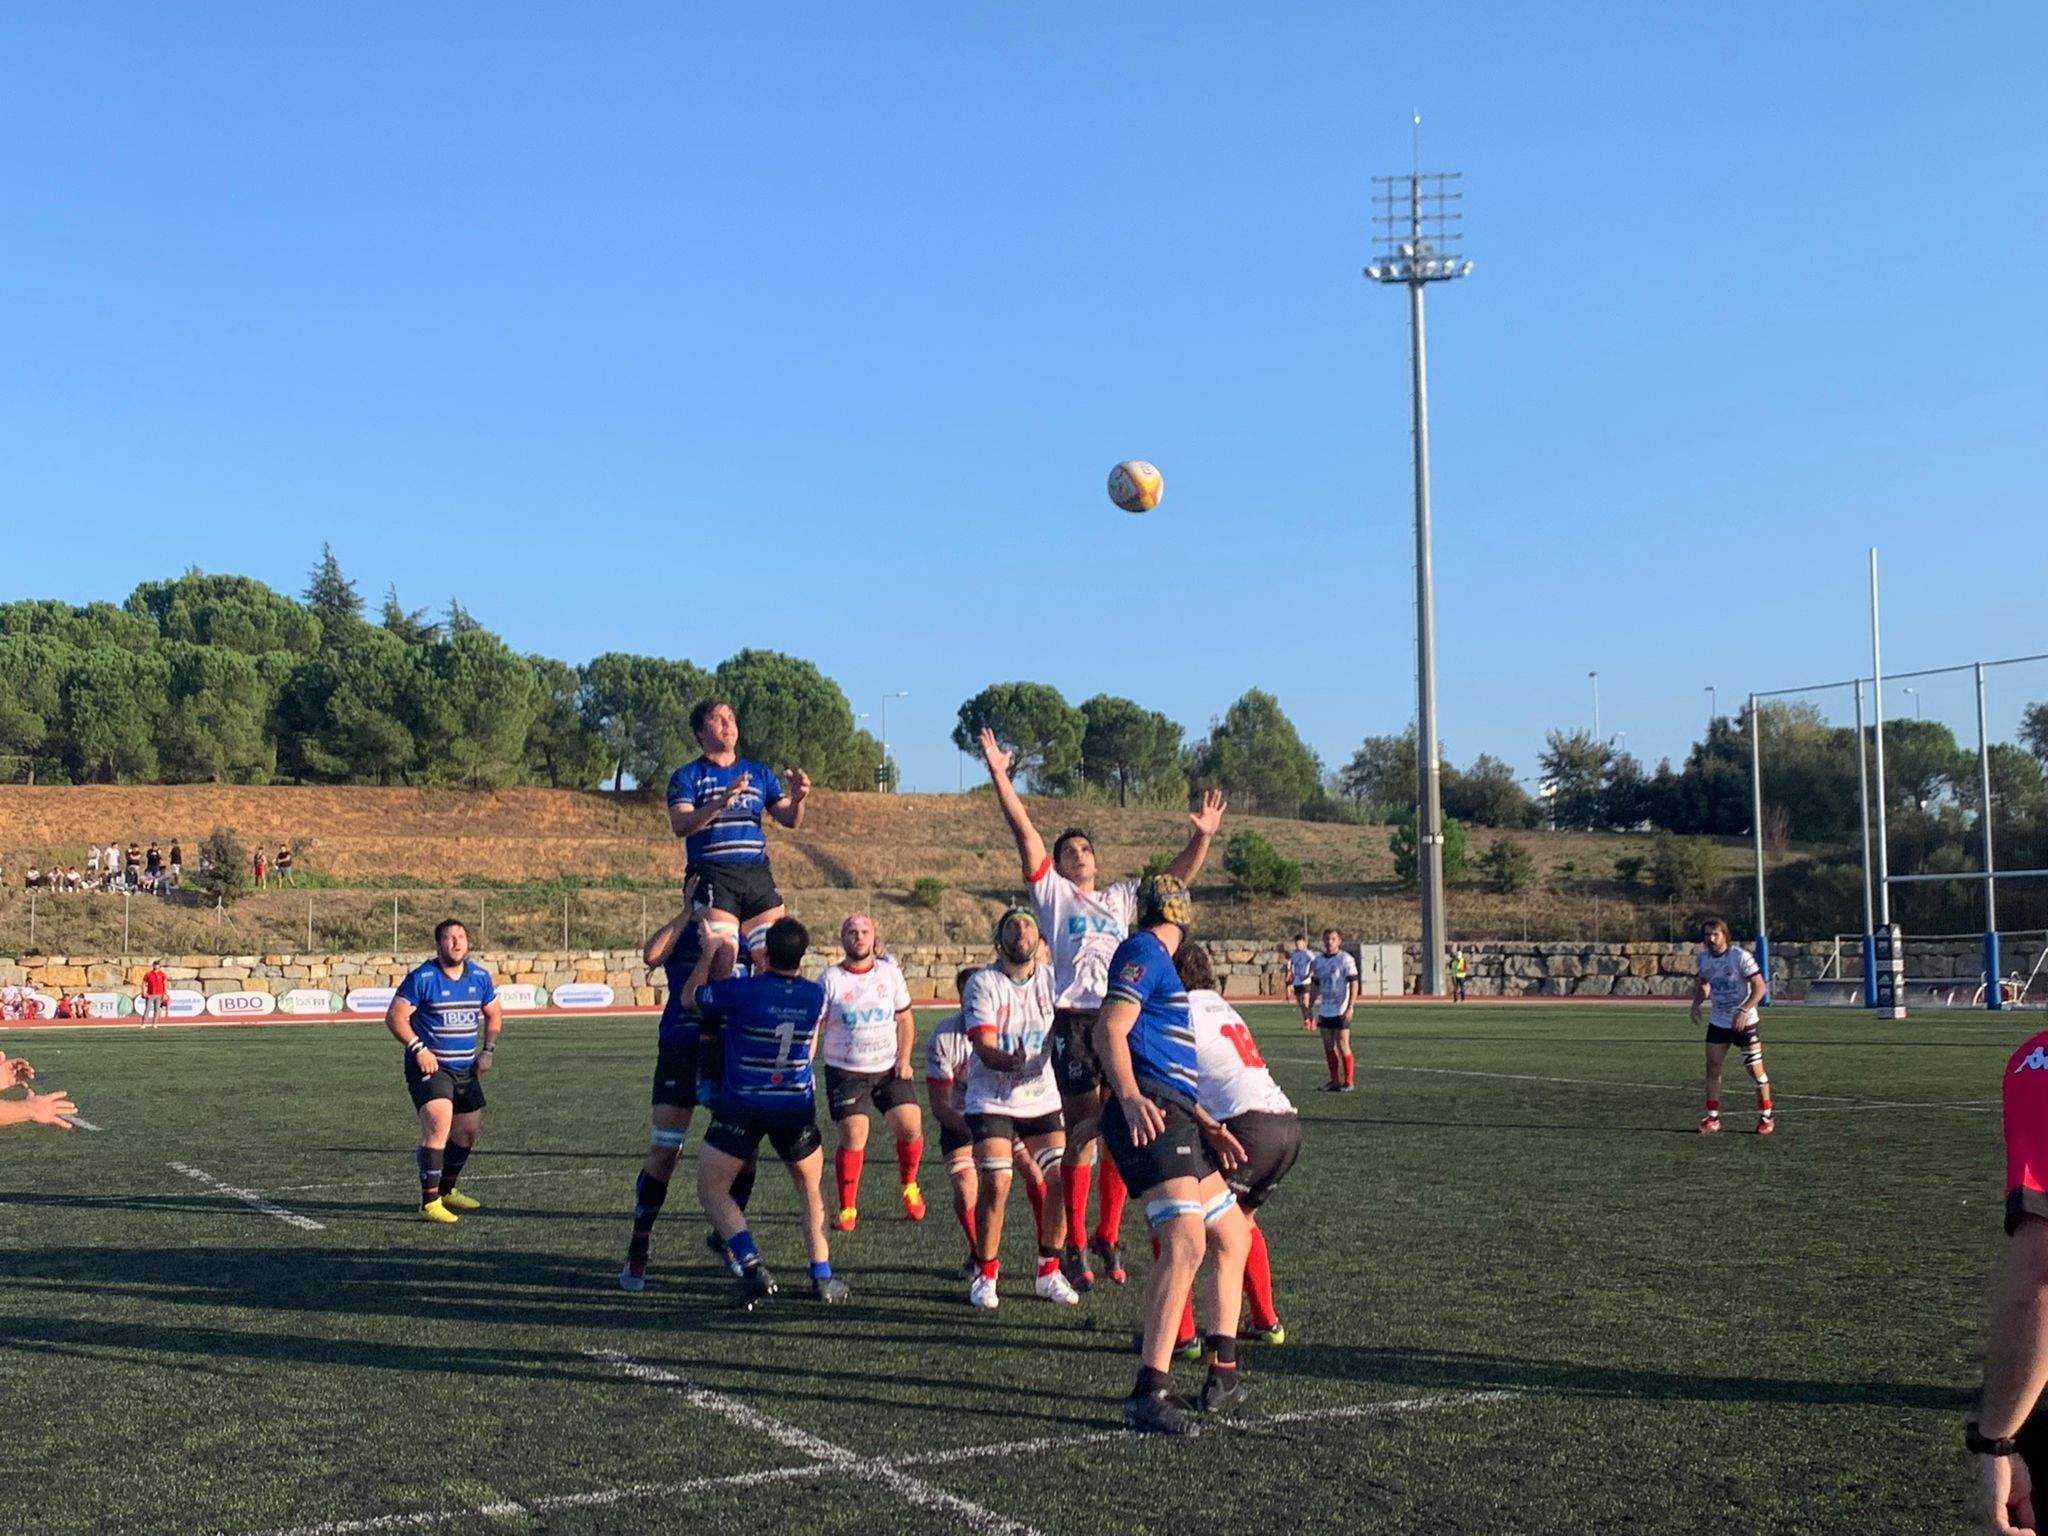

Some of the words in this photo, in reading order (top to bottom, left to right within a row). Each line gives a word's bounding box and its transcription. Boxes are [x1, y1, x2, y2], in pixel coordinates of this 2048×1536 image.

[225, 996, 263, 1010] BDO
[448, 1011, 476, 1025] BDO
[774, 1022, 796, 1069] 1
